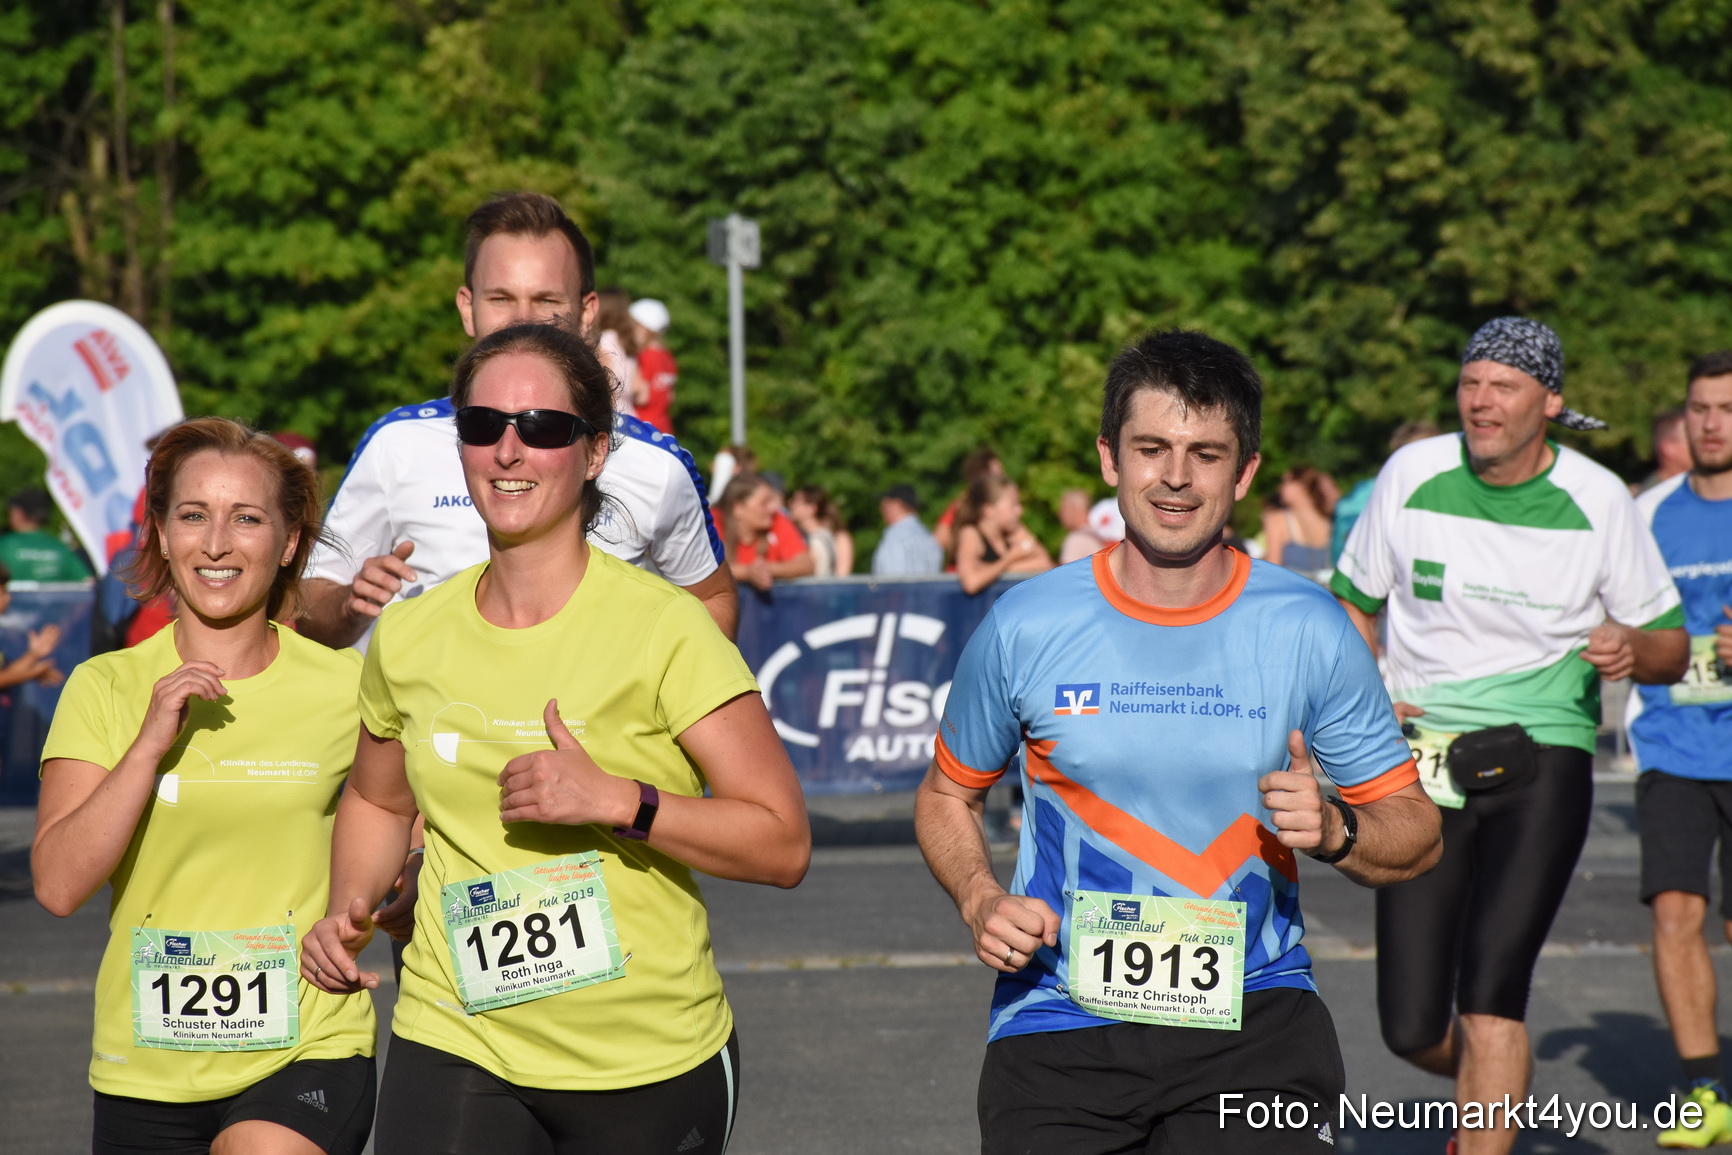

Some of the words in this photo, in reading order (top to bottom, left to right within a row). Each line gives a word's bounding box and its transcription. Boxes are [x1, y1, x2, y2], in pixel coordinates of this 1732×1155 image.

[433, 495, 472, 508] JAKO
[1111, 682, 1224, 698] Raiffeisenbank
[1110, 701, 1186, 715] Neumarkt
[1248, 706, 1267, 719] eG
[493, 719, 526, 727] Kliniken
[275, 760, 319, 768] Landkreises
[462, 894, 521, 919] firmenlauf
[563, 887, 594, 904] 2019
[466, 903, 586, 972] 1281
[1098, 917, 1166, 934] firmenlauf
[1204, 934, 1234, 945] 2019
[154, 954, 217, 966] firmenlauf
[255, 958, 285, 970] 2019
[501, 966, 531, 982] Roth
[535, 960, 563, 978] Inga
[1093, 939, 1220, 991] 1913
[495, 980, 531, 994] Klinikum
[532, 969, 576, 984] Neumarkt
[152, 972, 268, 1017] 1291
[1103, 986, 1139, 999] Franz
[1143, 989, 1207, 1006] Christoph
[1079, 995, 1138, 1009] Raiffeisenbank
[1140, 1002, 1180, 1013] Neumarkt
[1190, 1005, 1198, 1014] d.
[1199, 1007, 1217, 1017] Opf.
[1218, 1008, 1230, 1016] eG
[162, 1017, 217, 1030] Schuster
[220, 1018, 265, 1030] Nadine
[173, 1030, 209, 1039] Klinikum
[211, 1031, 253, 1039] Neumarkt
[297, 1094, 329, 1113] adidas
